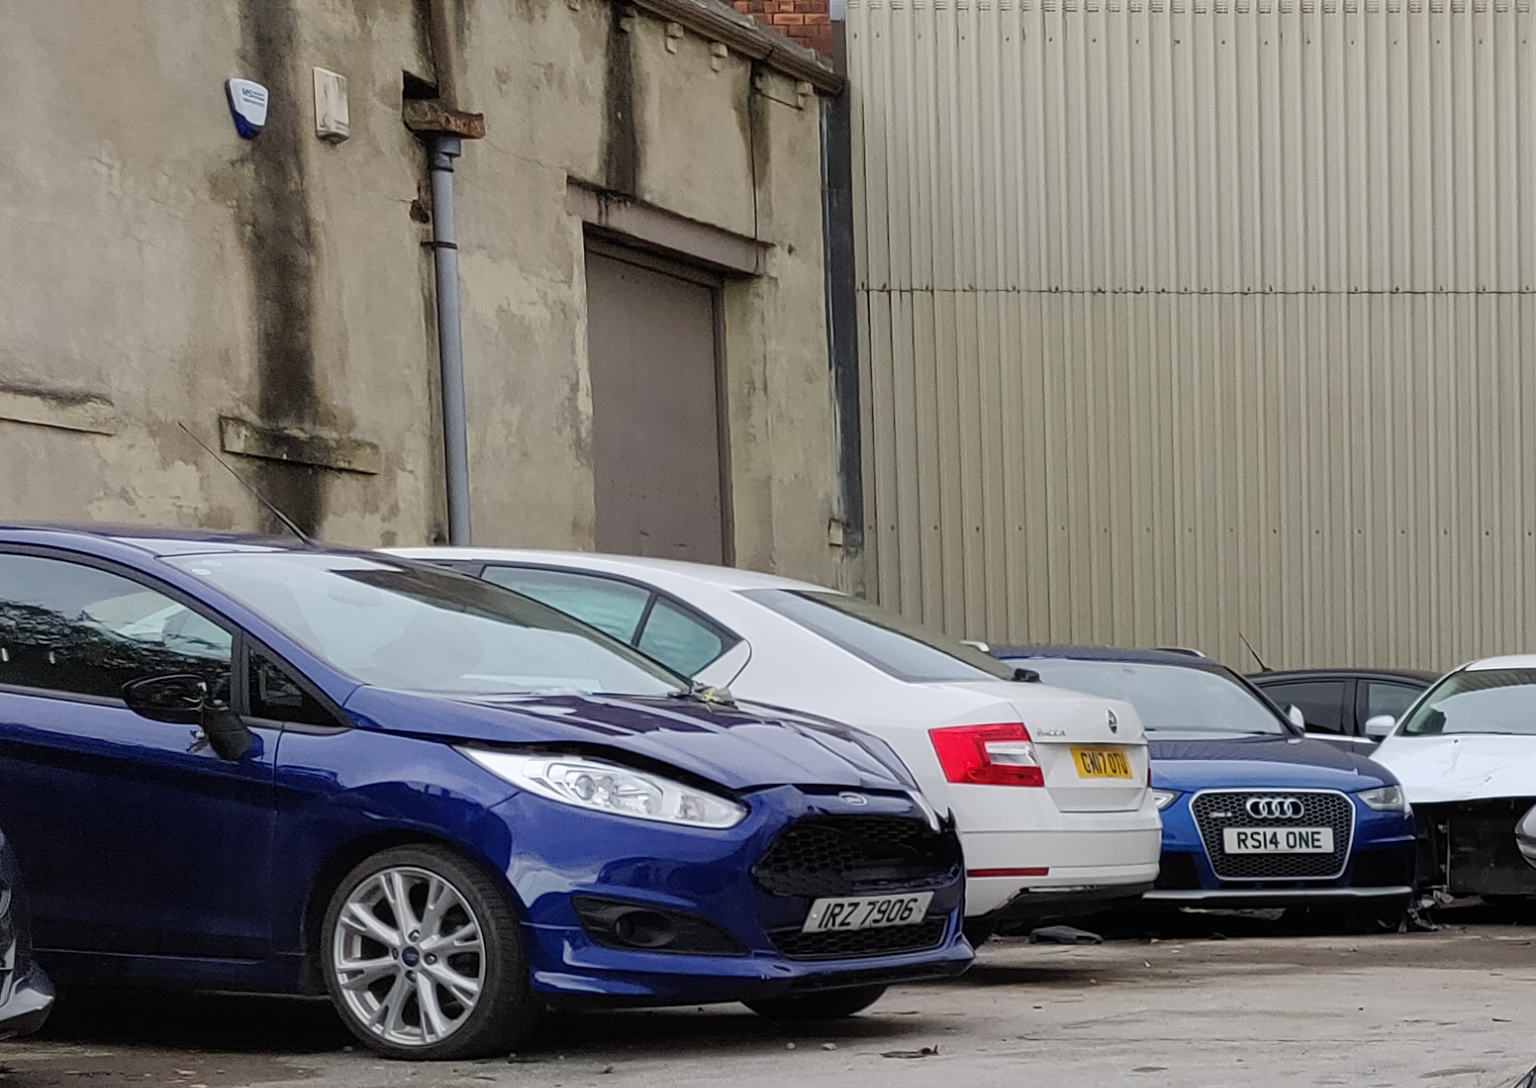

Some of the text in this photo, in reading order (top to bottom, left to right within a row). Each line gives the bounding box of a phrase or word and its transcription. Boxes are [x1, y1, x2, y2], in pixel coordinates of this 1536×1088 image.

[1236, 831, 1323, 850] RS14 ONE
[817, 897, 919, 929] IRZ 7906
